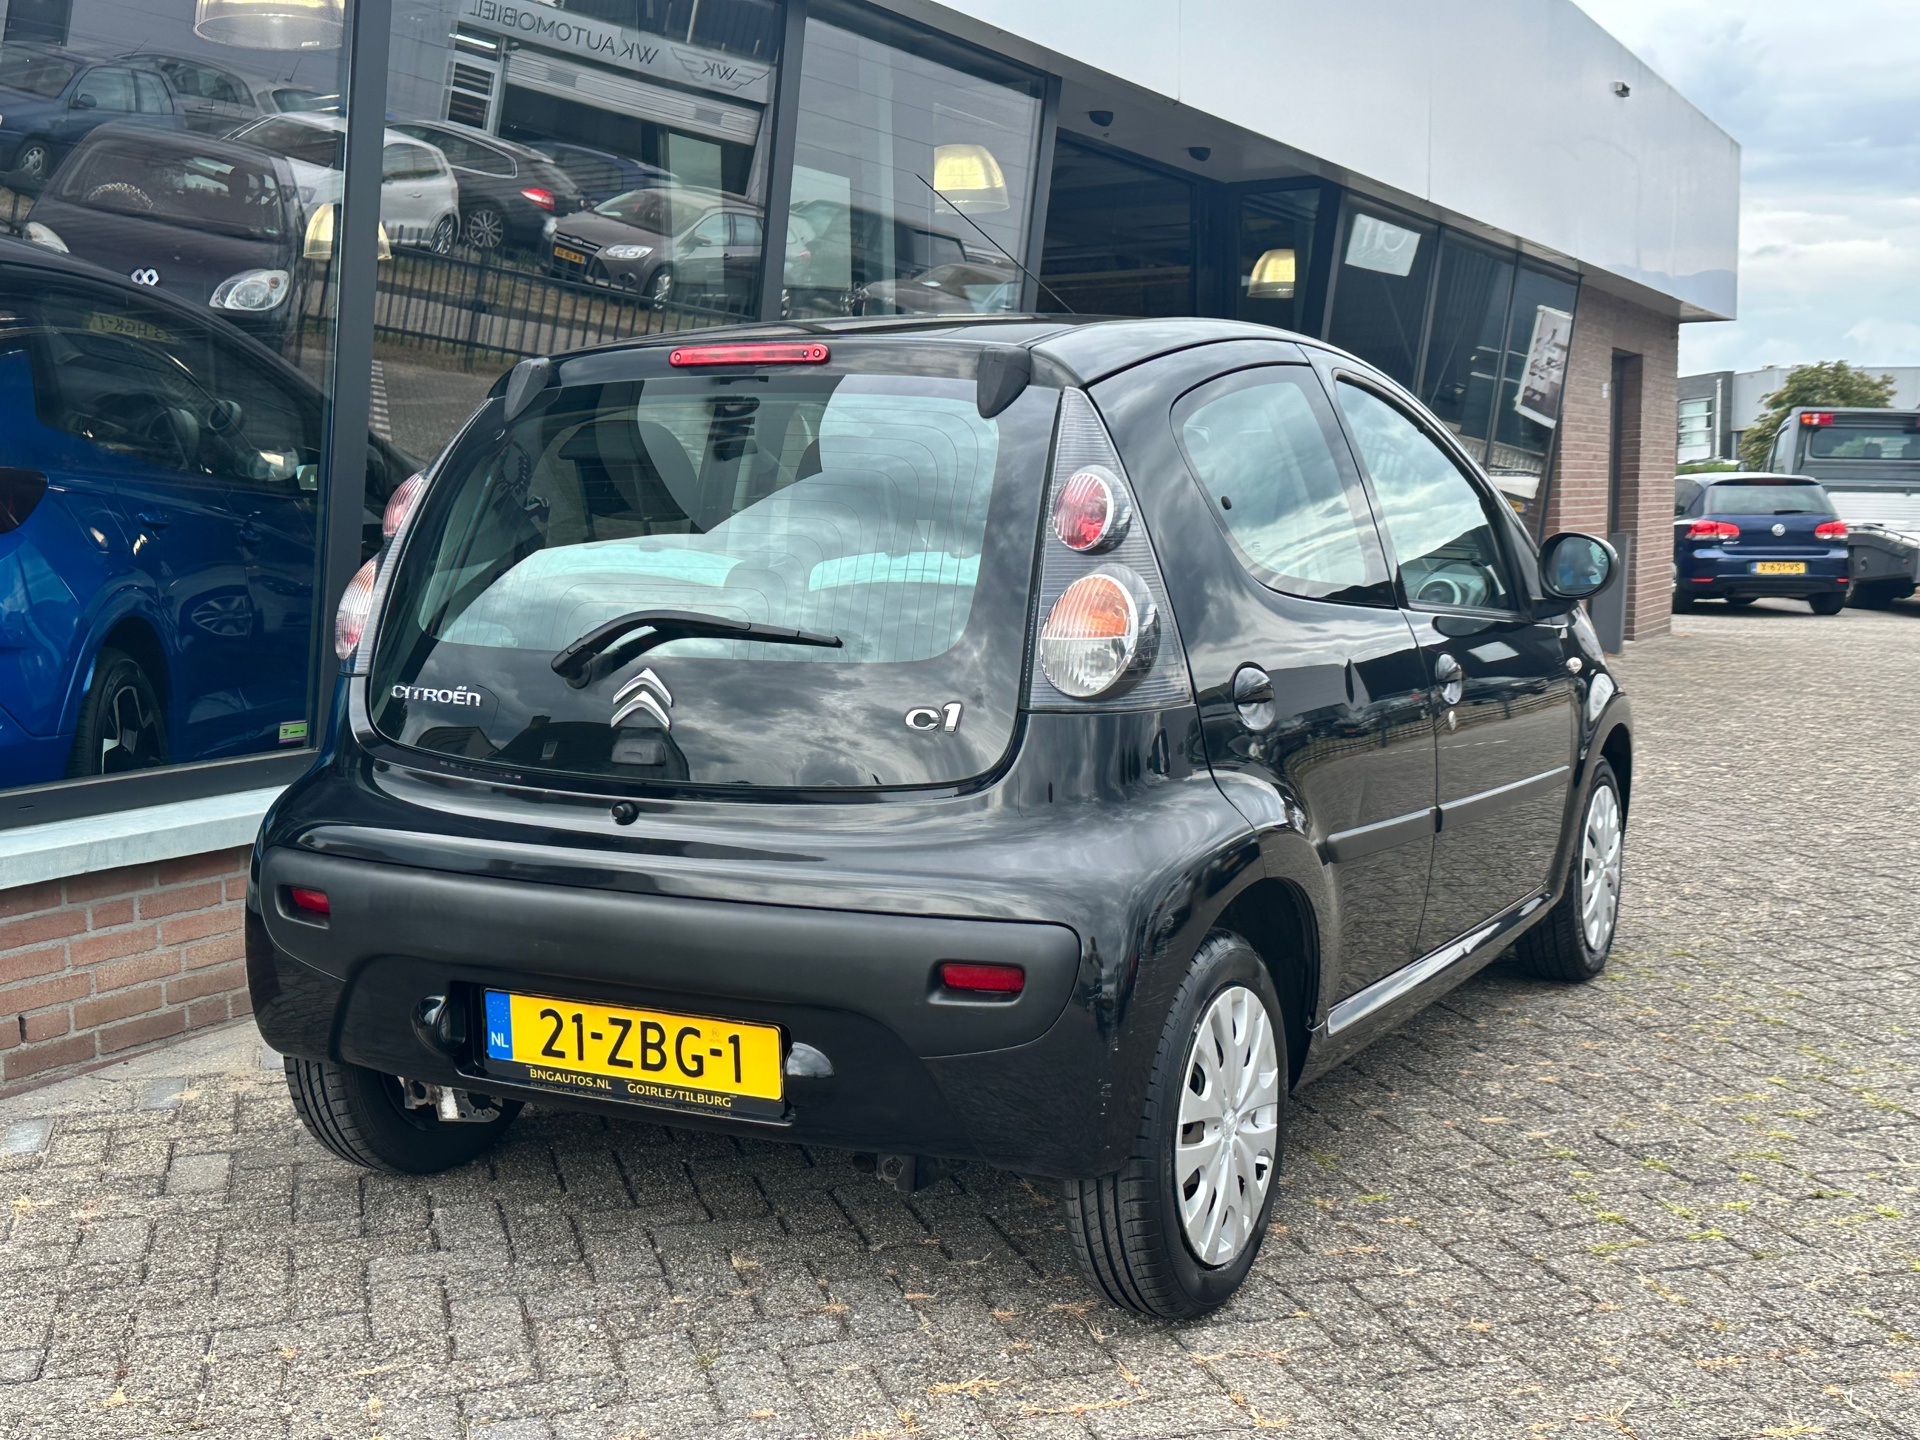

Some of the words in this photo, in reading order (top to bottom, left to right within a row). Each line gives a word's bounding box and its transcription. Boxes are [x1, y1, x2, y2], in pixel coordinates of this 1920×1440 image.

[905, 702, 962, 732] C1
[491, 1031, 509, 1048] NL
[539, 1008, 742, 1084] 21-ZBG-1
[529, 1068, 612, 1090] BNGAUTOS.NL
[627, 1082, 732, 1108] GOIRLE/TILBURG
